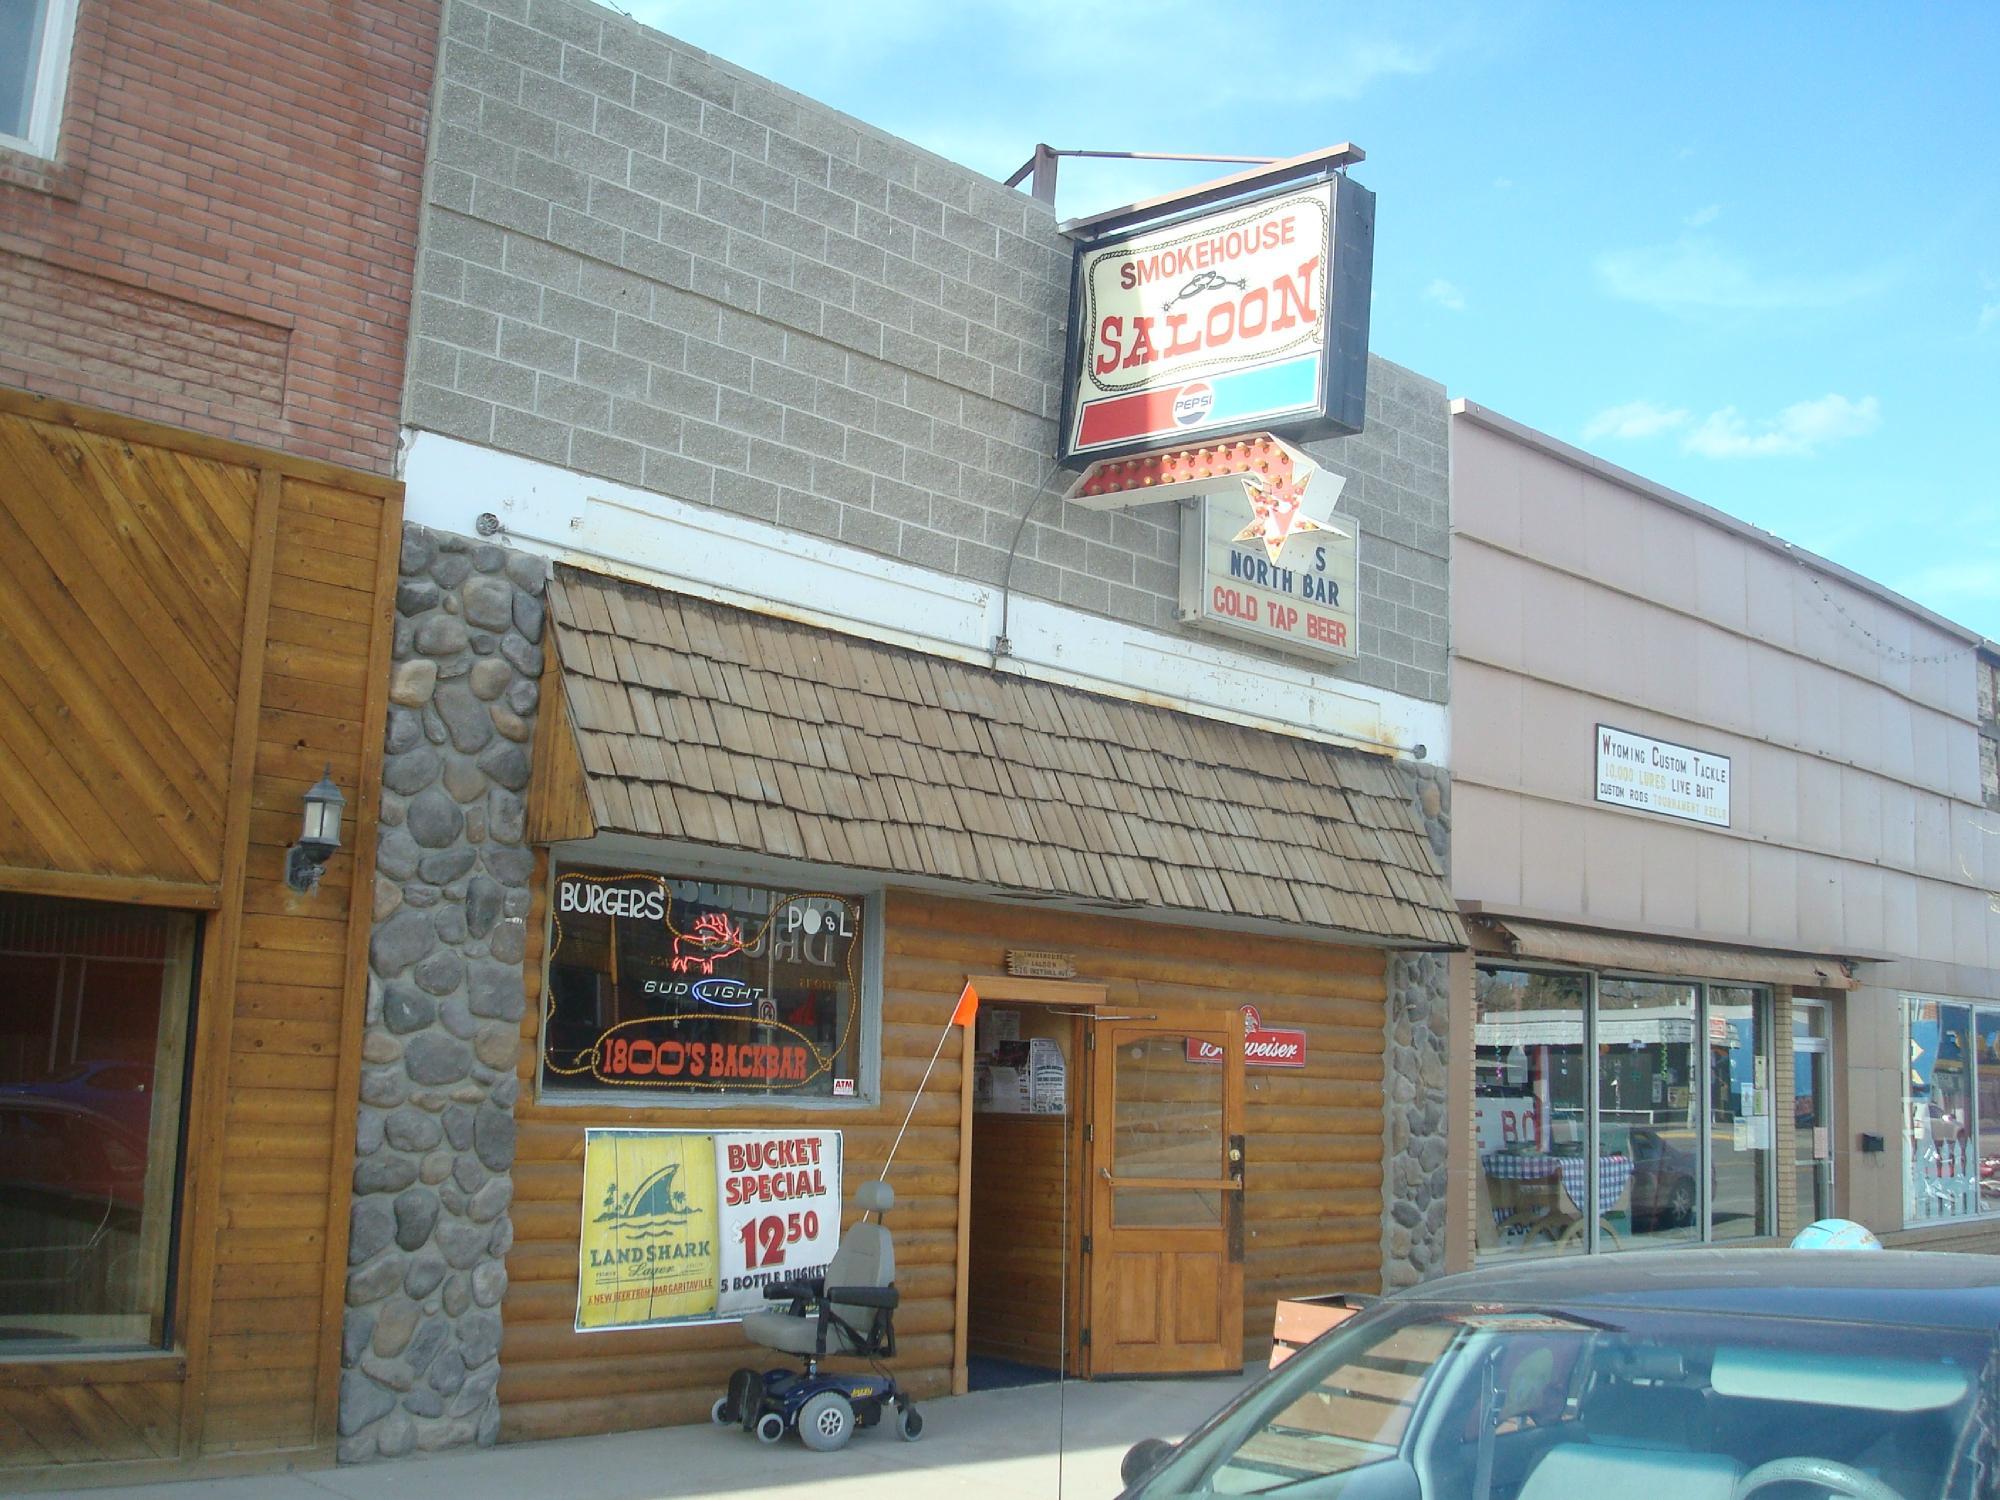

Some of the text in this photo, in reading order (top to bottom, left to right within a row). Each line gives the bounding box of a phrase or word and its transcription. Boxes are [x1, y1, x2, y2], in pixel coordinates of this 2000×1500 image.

[1121, 216, 1296, 290] SMOKEHOUSE
[1095, 256, 1319, 375] SALOON
[1175, 394, 1212, 412] PEPSI
[1230, 550, 1339, 607] NORTH BAR
[1213, 585, 1347, 647] COLD TAP BEER
[1600, 783, 1624, 798] CUSTOM
[1630, 789, 1649, 803] RODS
[1639, 770, 1666, 790] LURES
[1672, 779, 1691, 796] LIVE
[1696, 784, 1714, 800] BAIT
[560, 882, 664, 920] BURGERS
[644, 980, 764, 999] BUD LIGHT
[603, 1039, 808, 1080] 1800'S BACKBAR
[835, 1080, 853, 1089] ATM
[727, 1137, 821, 1172] BUCKET
[725, 1168, 827, 1206] SPECIAL
[590, 1241, 711, 1267] LANDSHARK
[628, 1262, 675, 1278] Lager
[720, 1263, 830, 1294] 5 BOTTLE BUCKET
[594, 1293, 612, 1304] NEW
[629, 1287, 651, 1300] FROM
[651, 1278, 713, 1296] MARGARITAVILLE
